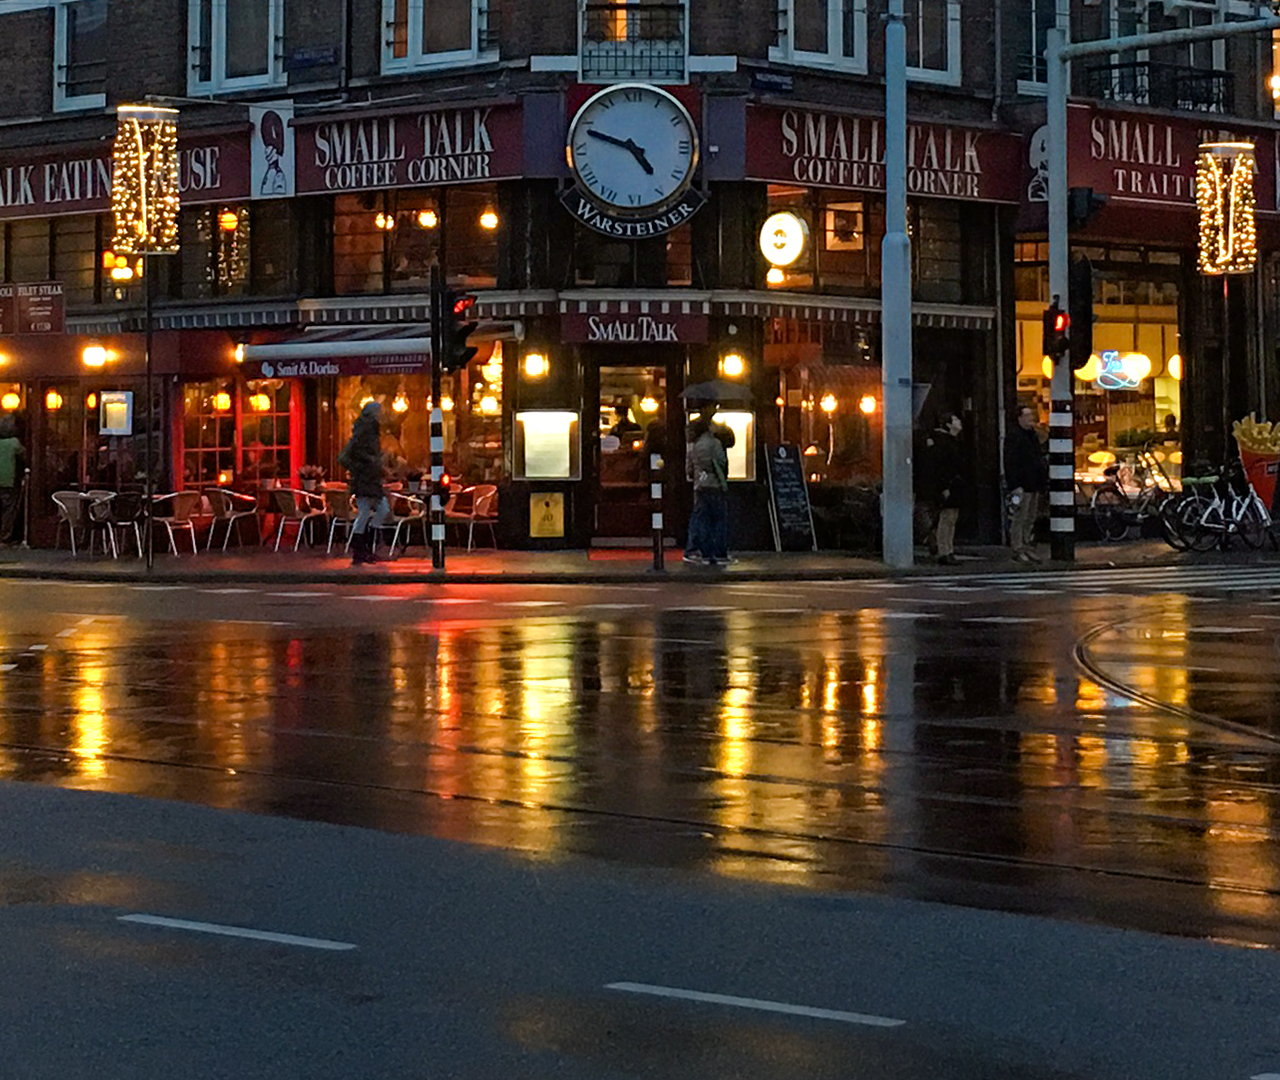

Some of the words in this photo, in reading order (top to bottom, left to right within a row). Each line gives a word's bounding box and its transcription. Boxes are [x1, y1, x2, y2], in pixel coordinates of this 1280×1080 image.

[623, 92, 642, 102] XII
[315, 119, 405, 167] SMALL
[418, 108, 494, 157] TALK
[679, 141, 689, 154] III
[781, 109, 886, 164] SMALL
[907, 125, 982, 173] TALK
[1090, 117, 1180, 167] SMALL
[44, 157, 115, 203] EATIN
[325, 162, 397, 189] COFFEE
[408, 154, 490, 182] CORNER
[580, 163, 598, 187] VIII
[793, 156, 881, 187] COFFEE
[908, 169, 979, 197] ORNER
[600, 185, 617, 202] VII
[628, 195, 642, 205] VI
[577, 198, 694, 235] WARSTEINER
[588, 315, 639, 341] SMALL
[638, 316, 679, 341] TALK
[277, 362, 298, 376] Smit
[299, 362, 308, 375] &
[309, 361, 340, 375] Dorlas
